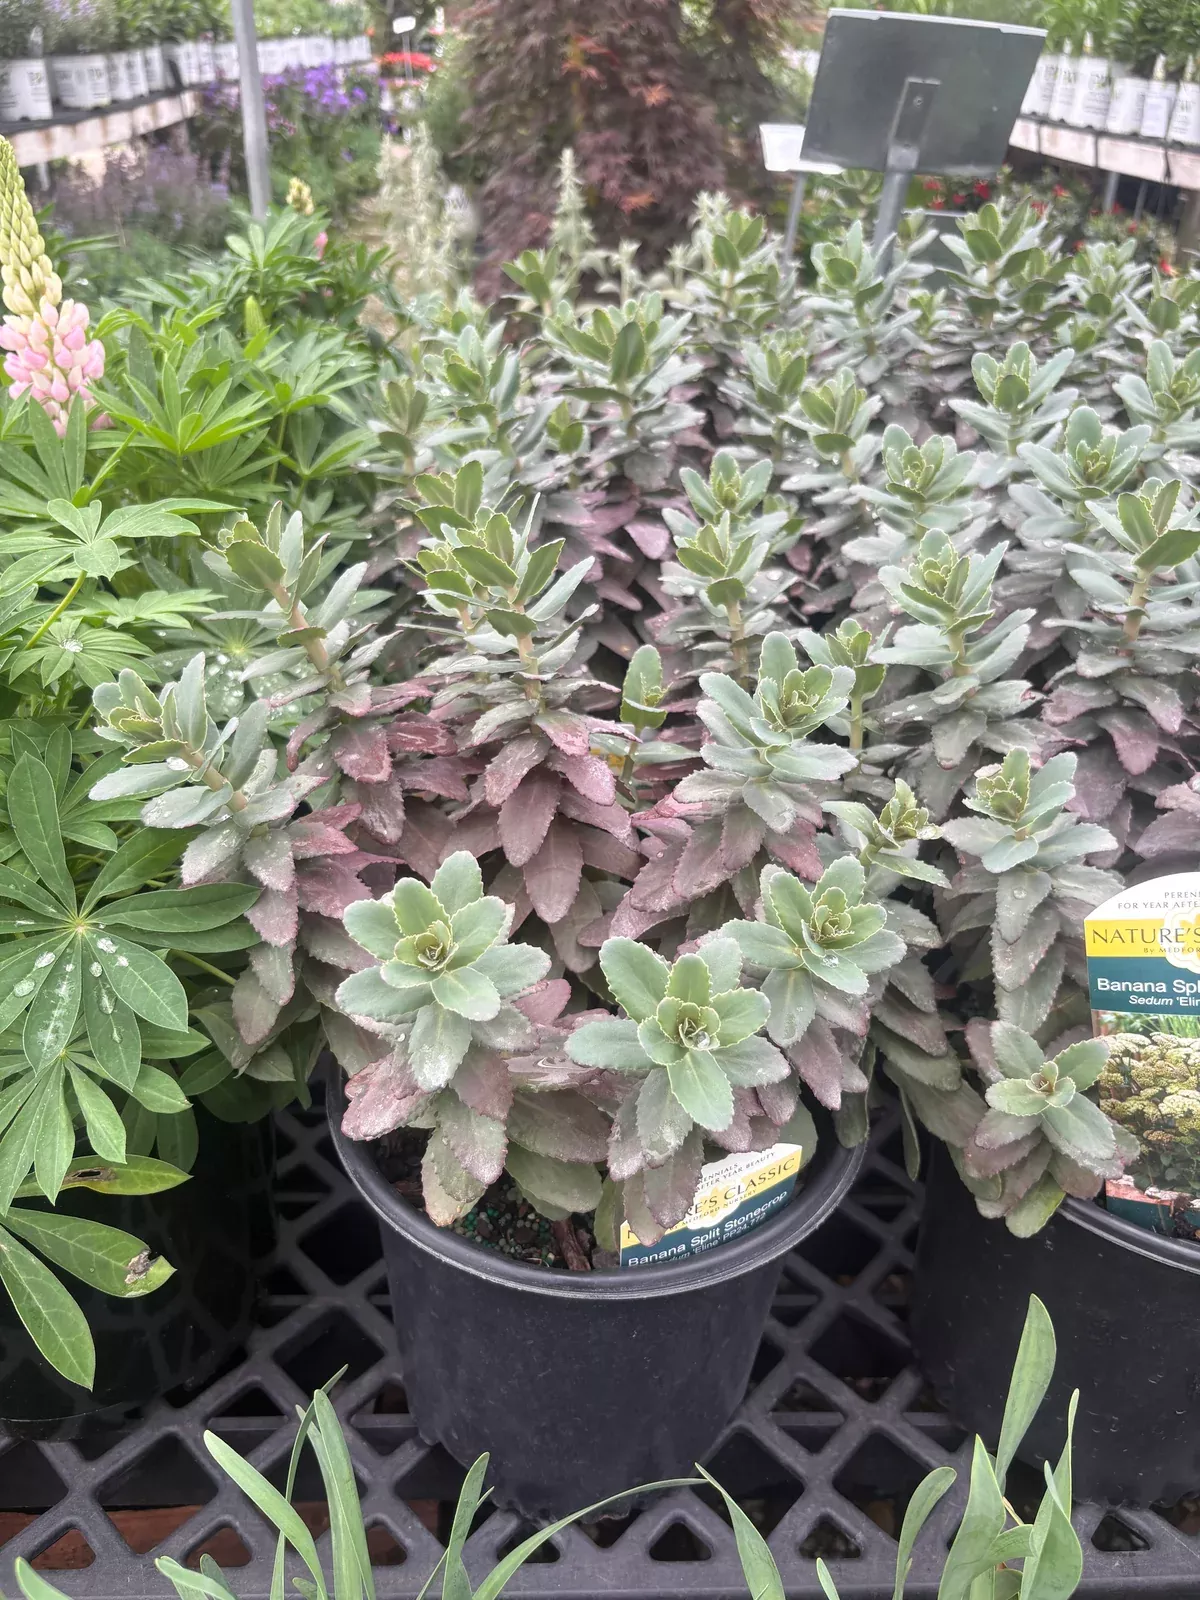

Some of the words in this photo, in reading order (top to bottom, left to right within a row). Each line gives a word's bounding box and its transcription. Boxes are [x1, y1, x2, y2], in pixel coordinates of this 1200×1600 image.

[1143, 901, 1169, 909] YEAR
[1092, 928, 1200, 944] NATURE'S
[1097, 978, 1166, 993] Banana
[1172, 979, 1200, 996] Spl
[1128, 995, 1173, 1006] Sedum
[723, 1167, 743, 1179] YEAR
[745, 1152, 775, 1169] BEAUTY
[724, 1157, 795, 1200] CLASSIC
[628, 1243, 686, 1267] Banana
[690, 1227, 720, 1247] Split
[724, 1191, 787, 1231] Stonecrop
